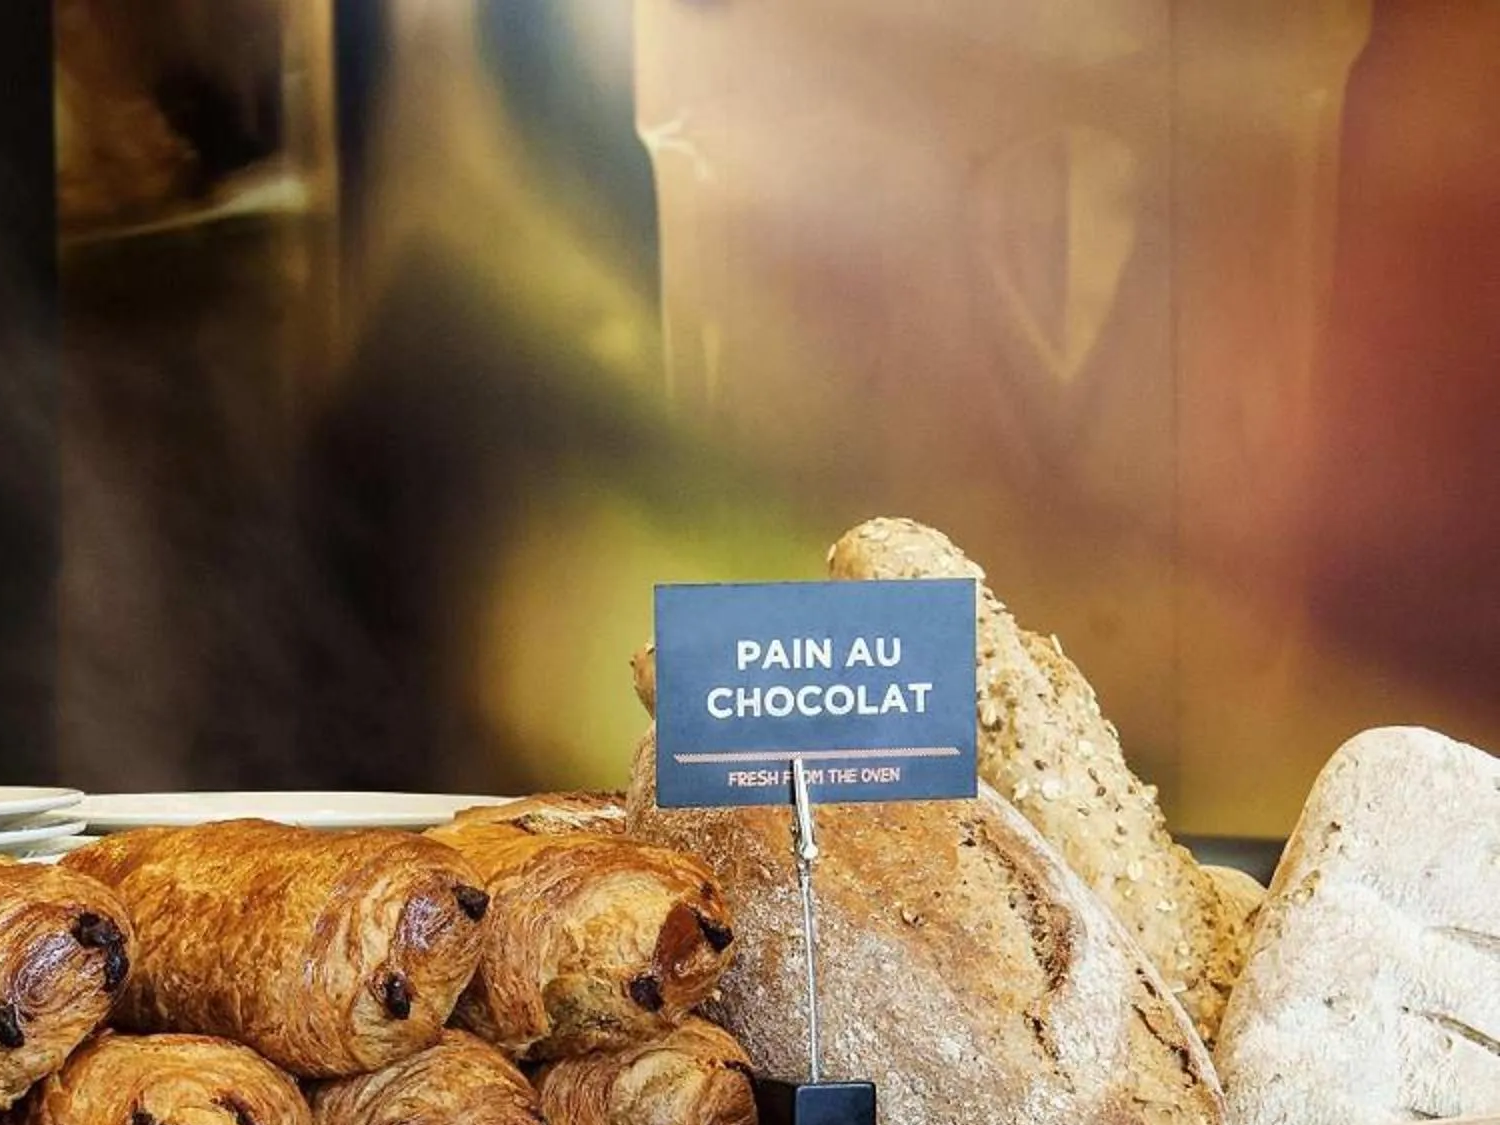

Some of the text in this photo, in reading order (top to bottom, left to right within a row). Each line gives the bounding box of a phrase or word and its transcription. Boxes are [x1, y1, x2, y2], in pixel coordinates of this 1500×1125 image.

[736, 637, 901, 670] PAIN AU
[706, 683, 933, 719] CHOCOLAT
[728, 767, 901, 788] FRESH FOM THE OVEN
